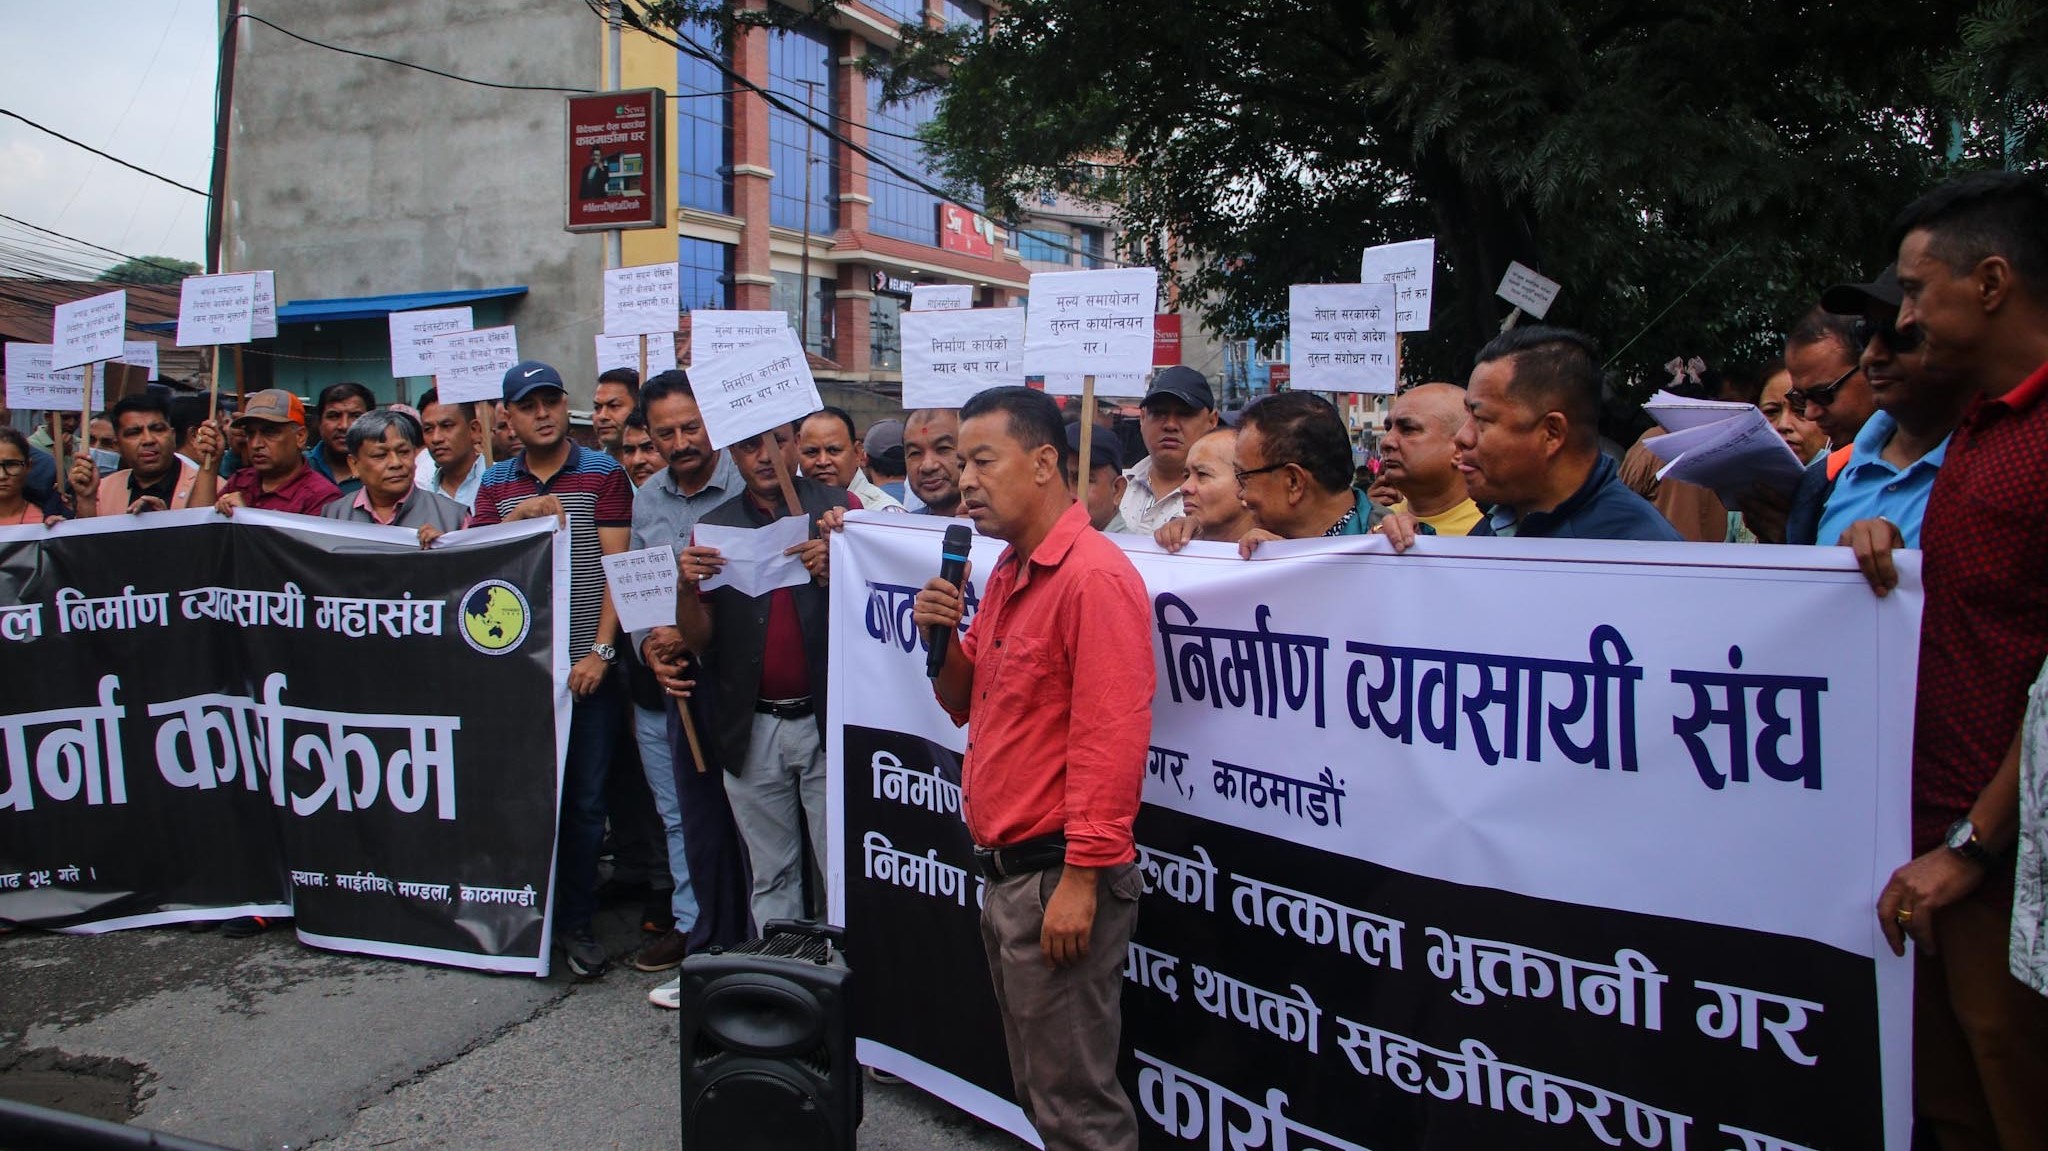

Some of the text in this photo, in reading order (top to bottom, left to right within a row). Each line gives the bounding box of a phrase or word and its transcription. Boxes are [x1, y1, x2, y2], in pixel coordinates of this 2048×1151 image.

[1086, 290, 1140, 307] समायोजन
[1314, 305, 1381, 320] नेपाल सरकारको
[1050, 319, 1080, 336] तुरुन्त
[1310, 331, 1329, 341] म्याद
[1361, 328, 1386, 342] आदेश
[932, 334, 1008, 353] निर्माण कार्यको
[1082, 342, 1099, 354] गर
[932, 362, 957, 374] म्याद
[984, 361, 1000, 372] गर
[1308, 353, 1330, 368] तुरुन्त
[1335, 350, 1366, 364] संशोधन
[1370, 354, 1383, 365] गर
[722, 356, 792, 392] निर्माण कार्यको
[729, 394, 752, 409] म्याद
[776, 380, 790, 391] गर
[56, 585, 169, 633] निर्माण
[180, 582, 304, 630] व्यवसायी
[314, 592, 446, 638] महासंघ
[1154, 592, 1329, 729] निर्माण
[1346, 624, 1644, 772] व्यवसायी
[1670, 644, 1828, 790] संघ
[1212, 766, 1346, 828] काठमाडौं
[57, 864, 80, 882] गते
[872, 750, 1824, 1066] निर्माण रुको तत्काल भुक्तानी गर
[863, 831, 967, 906] निर्माण
[1192, 963, 1322, 1054] थपको
[1336, 1016, 1693, 1151] सहजीकरण
